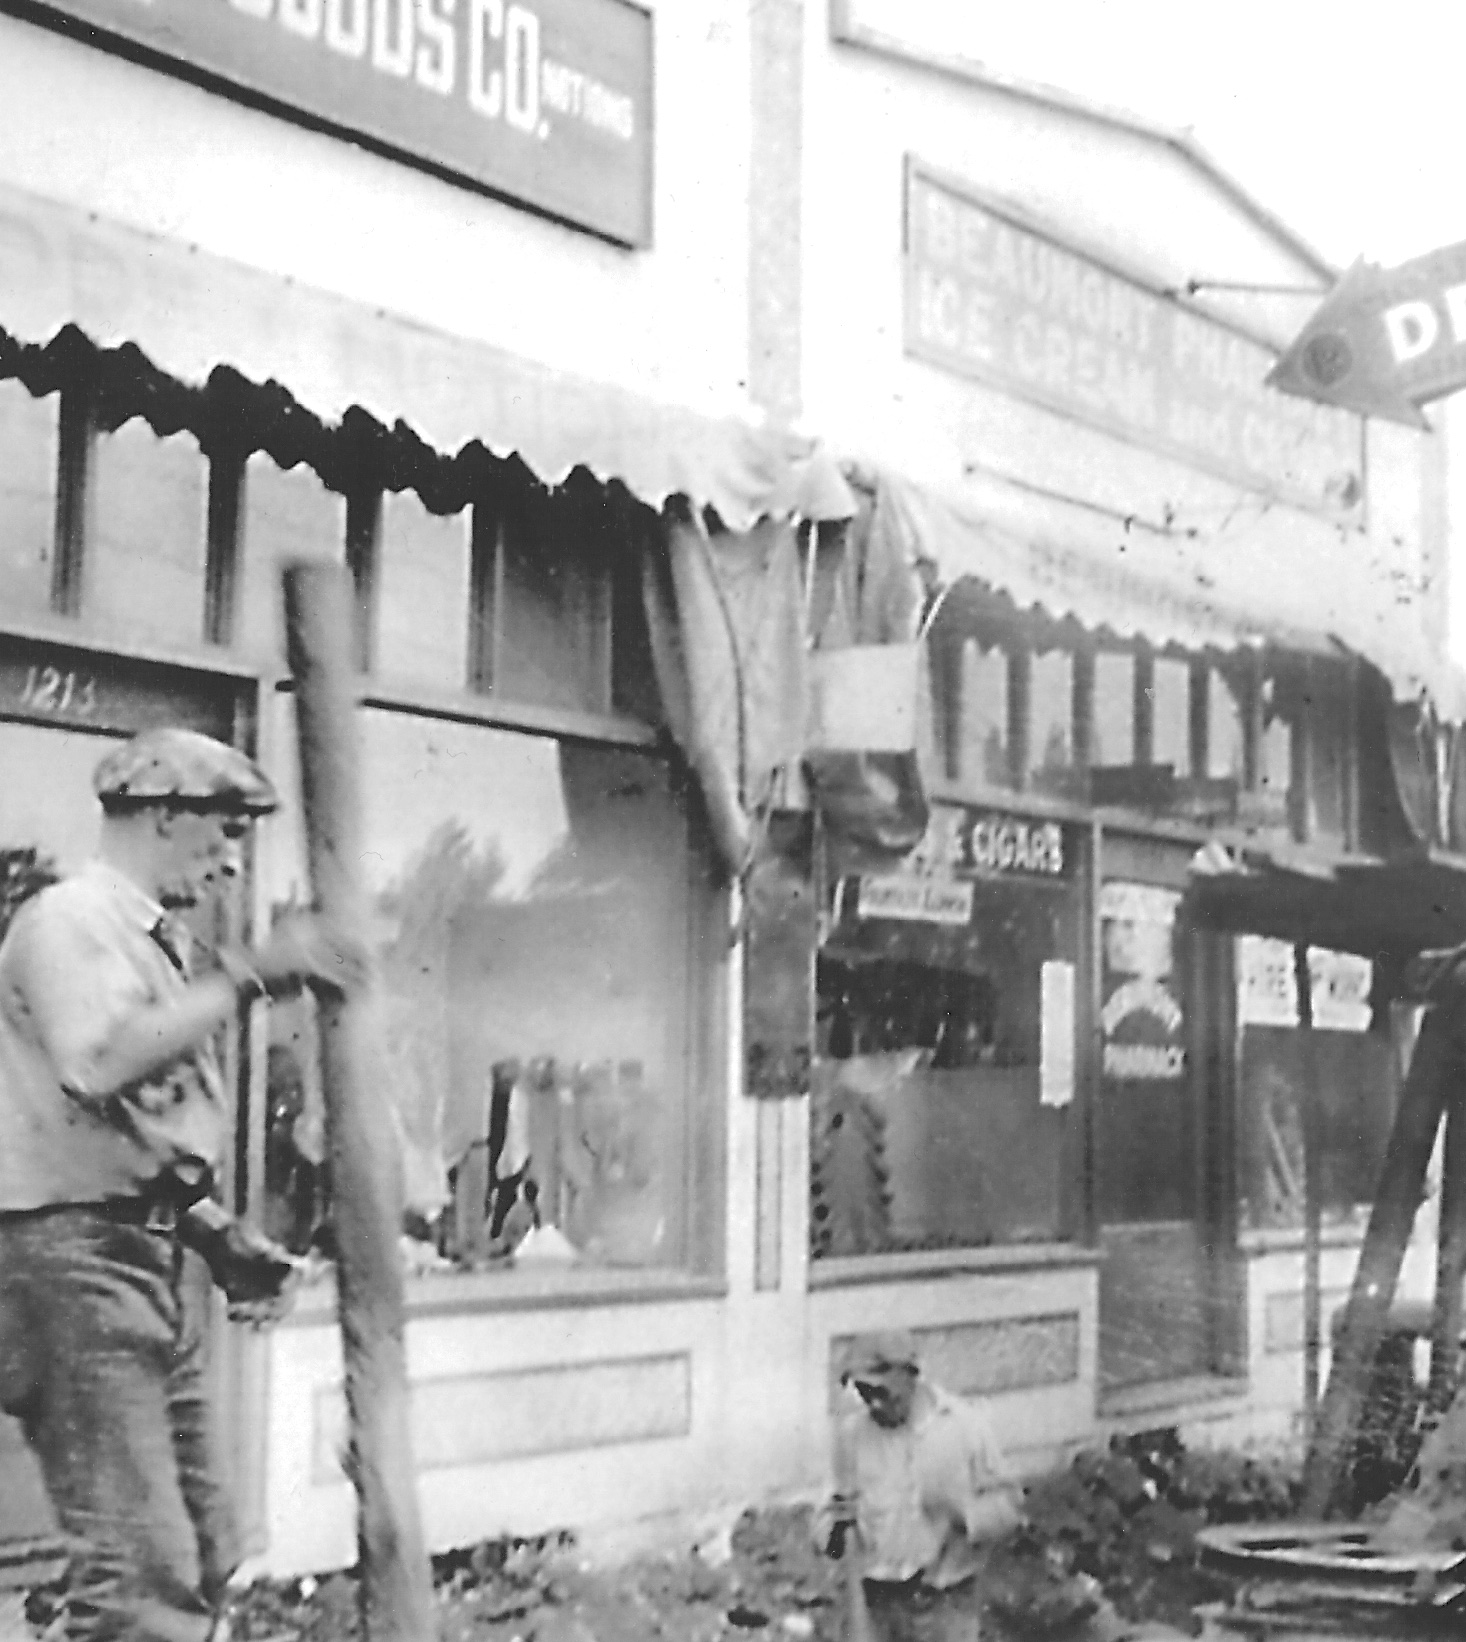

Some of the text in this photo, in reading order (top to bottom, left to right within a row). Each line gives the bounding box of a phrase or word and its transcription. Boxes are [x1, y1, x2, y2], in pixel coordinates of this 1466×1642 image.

[469, 0, 550, 140] CO.
[926, 190, 1157, 352] BEAUMONT
[918, 266, 996, 361] ICE
[1014, 311, 1159, 428] CREAM
[971, 820, 1064, 874] CIGARS
